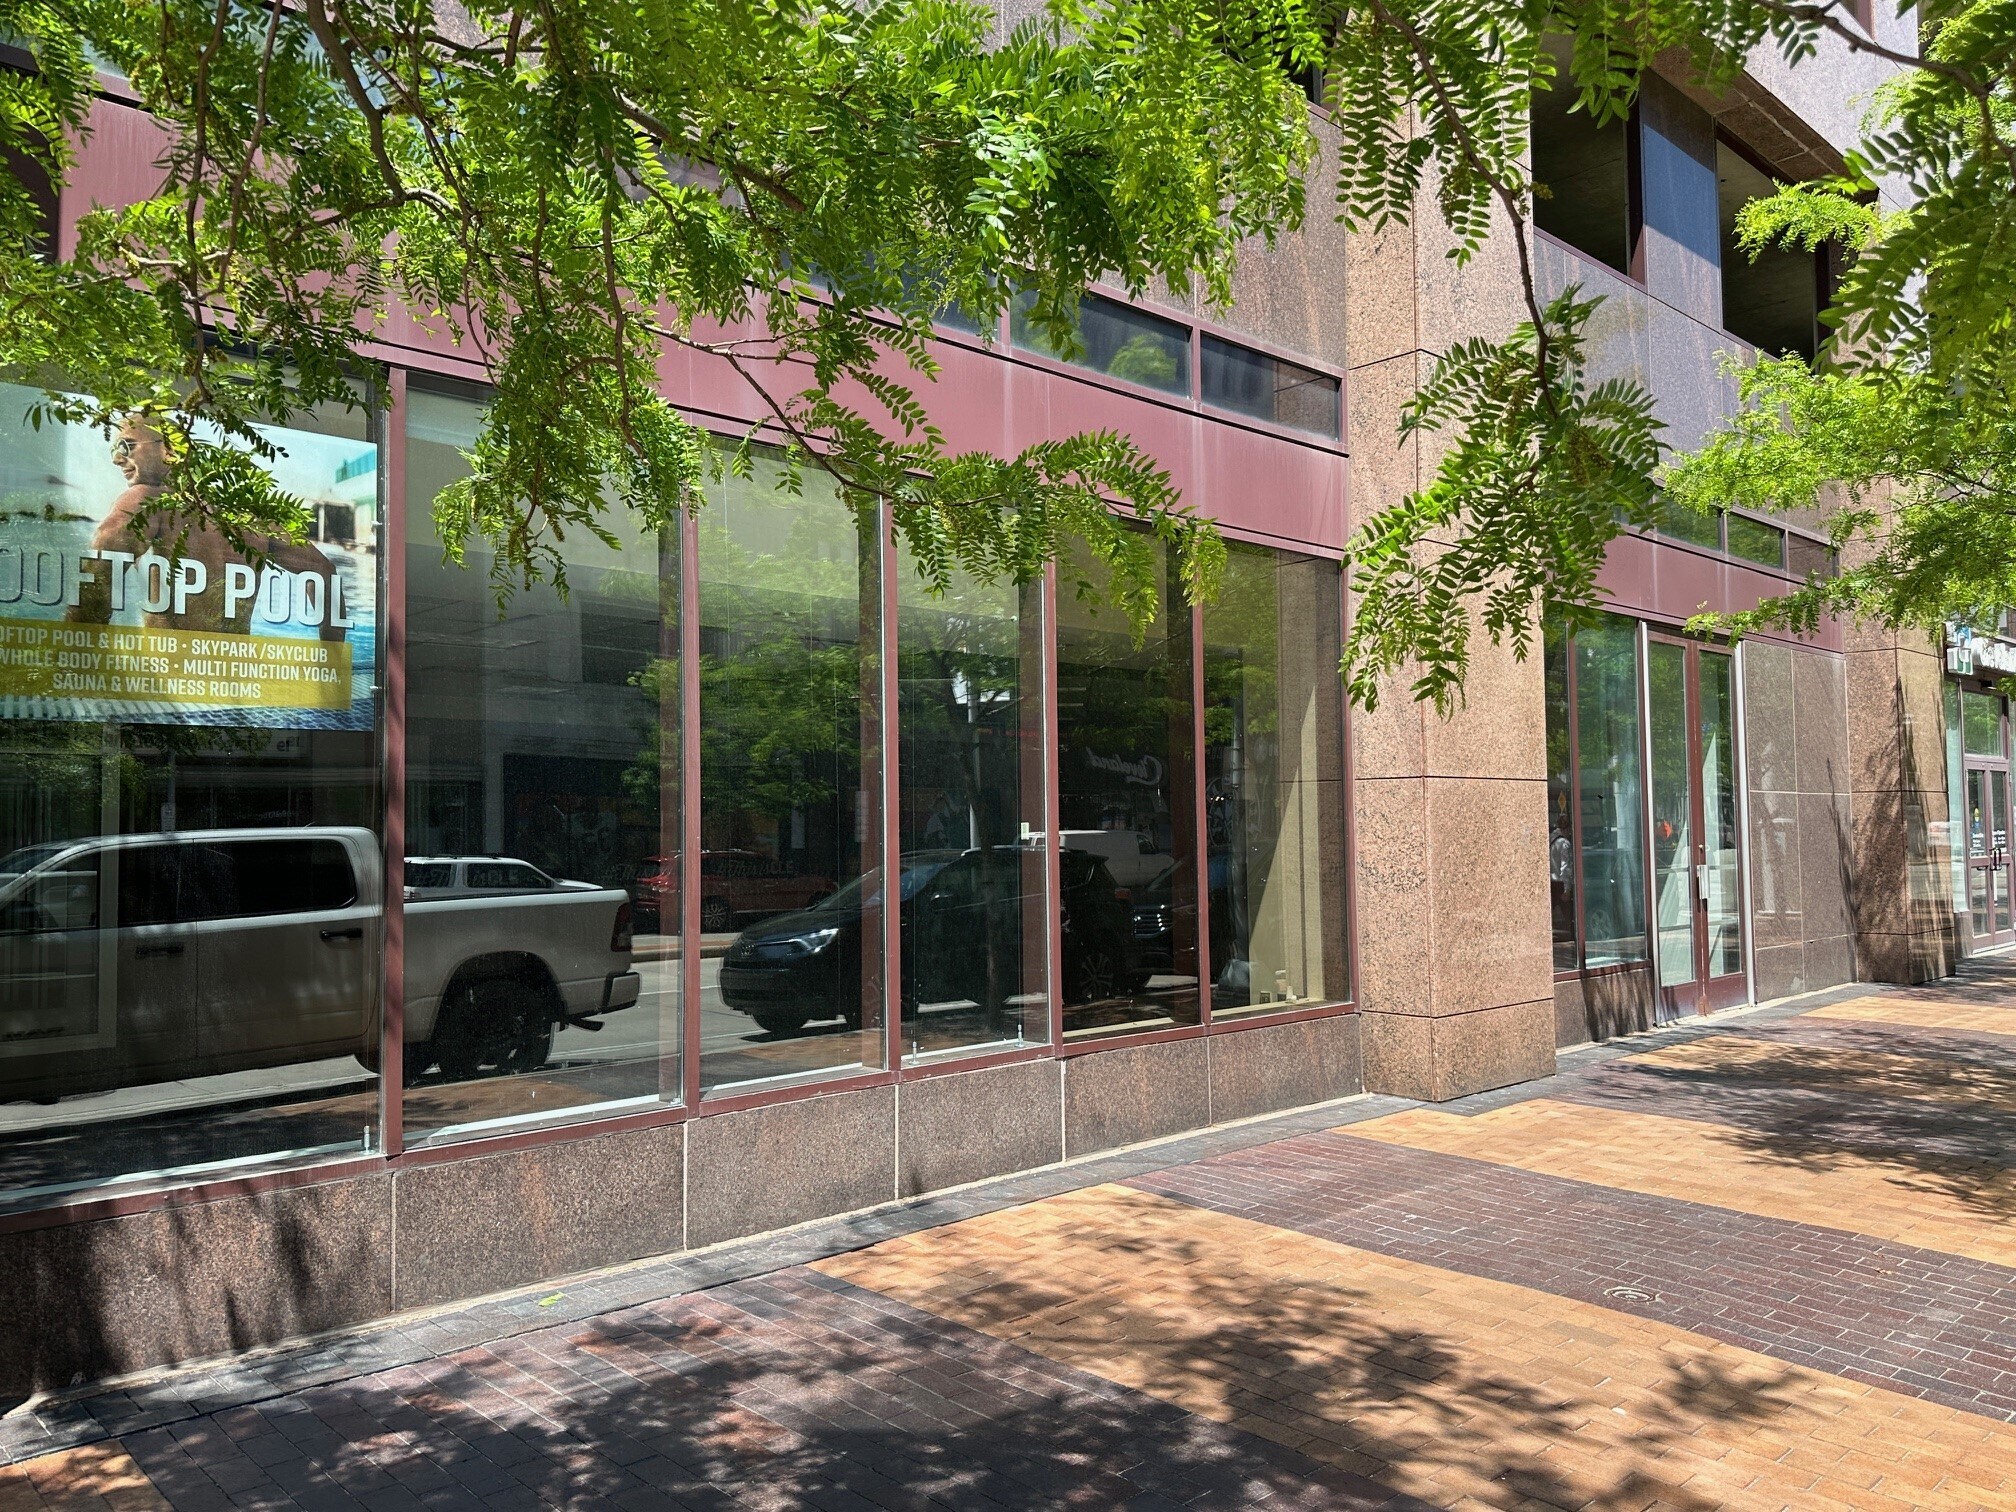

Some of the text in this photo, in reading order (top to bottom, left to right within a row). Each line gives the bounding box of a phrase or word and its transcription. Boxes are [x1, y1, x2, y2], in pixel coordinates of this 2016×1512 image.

[225, 560, 354, 629] POOL
[52, 629, 95, 648] POOL
[99, 632, 109, 649] &
[114, 634, 144, 651] HOT
[148, 635, 178, 653] TUB
[0, 648, 342, 685] WHOLE BODY FITNESS MULTI FUNCTION YOGA,
[53, 673, 261, 699] SAUNA & WELLNESS ROOMS
